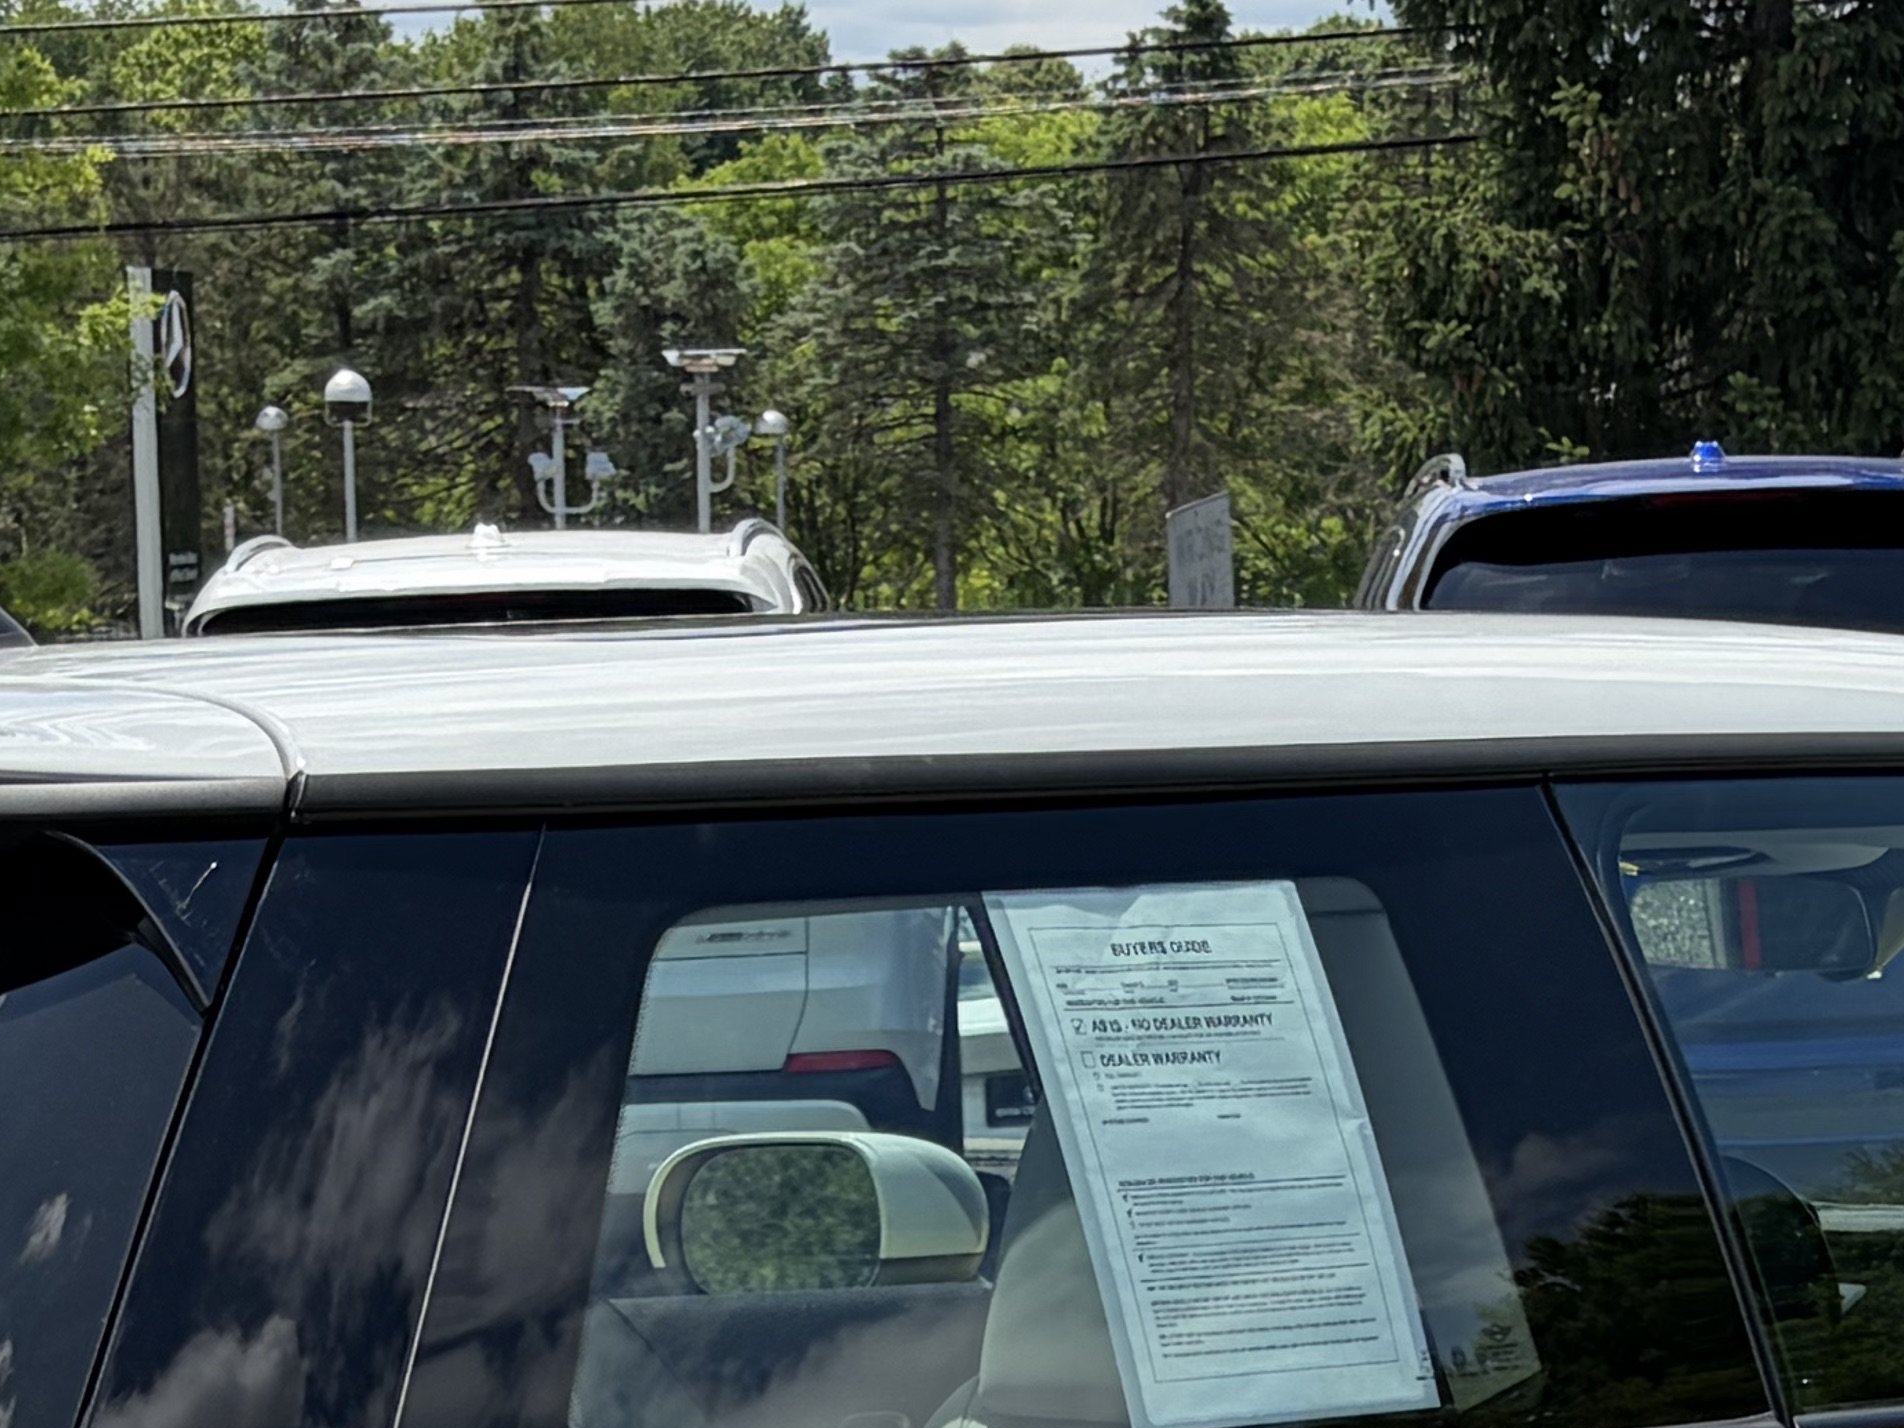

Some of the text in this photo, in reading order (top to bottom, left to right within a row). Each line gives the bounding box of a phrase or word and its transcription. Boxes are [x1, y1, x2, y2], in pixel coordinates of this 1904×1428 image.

[1110, 939, 1213, 957] BUYERS GUIDE
[1092, 1019, 1108, 1033] AS
[1109, 1018, 1123, 1033] IS
[1131, 1017, 1152, 1032] NO
[1152, 1015, 1203, 1031] DEALER
[1203, 1012, 1272, 1029] WARRANTY
[1099, 1050, 1221, 1068] DEALER WARRANTY
